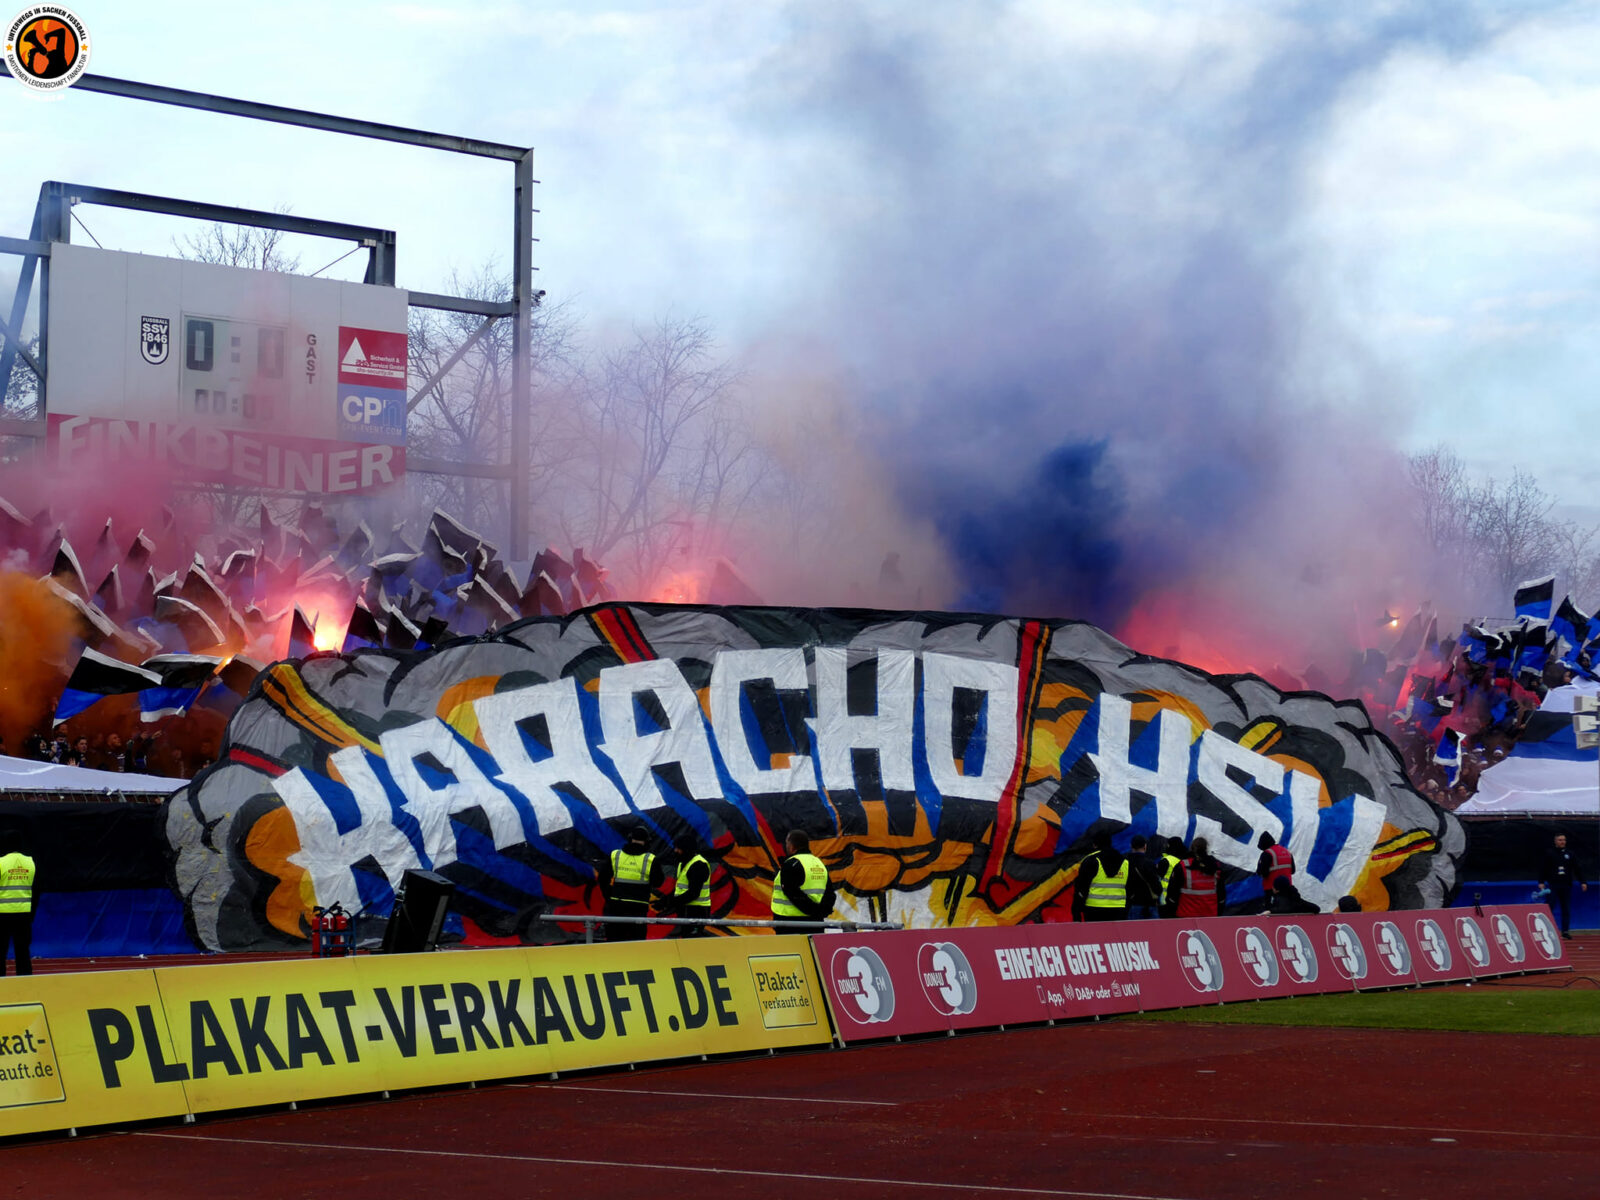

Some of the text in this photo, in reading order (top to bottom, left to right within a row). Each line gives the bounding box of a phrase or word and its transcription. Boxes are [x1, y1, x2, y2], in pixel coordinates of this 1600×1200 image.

[142, 317, 168, 325] FUSSBALL
[142, 323, 168, 334] SSV
[142, 333, 168, 344] 1846
[305, 333, 317, 385] GAST
[1088, 691, 1387, 913] HSV
[1245, 933, 1270, 980] 3
[1285, 931, 1309, 977] 3
[1335, 929, 1359, 973] 3
[1381, 927, 1403, 970] 3
[1423, 924, 1444, 966] 3
[1462, 922, 1483, 962] 3
[1497, 919, 1518, 958] 3
[1534, 918, 1555, 955] 3
[756, 971, 805, 992] Plakat-
[923, 950, 970, 1007] DONAU 3 FM
[994, 941, 1160, 981] EINFACH GUTE MUSIK.
[1187, 936, 1213, 985] 3
[762, 995, 811, 1010] verkauft.de
[837, 955, 887, 1015] DONAU 3 FM
[1075, 987, 1095, 1001] DAB+
[1095, 986, 1111, 999] oder
[1121, 983, 1141, 997] UKW
[87, 965, 739, 1089] PLAKAT-VERKAUFT.DE
